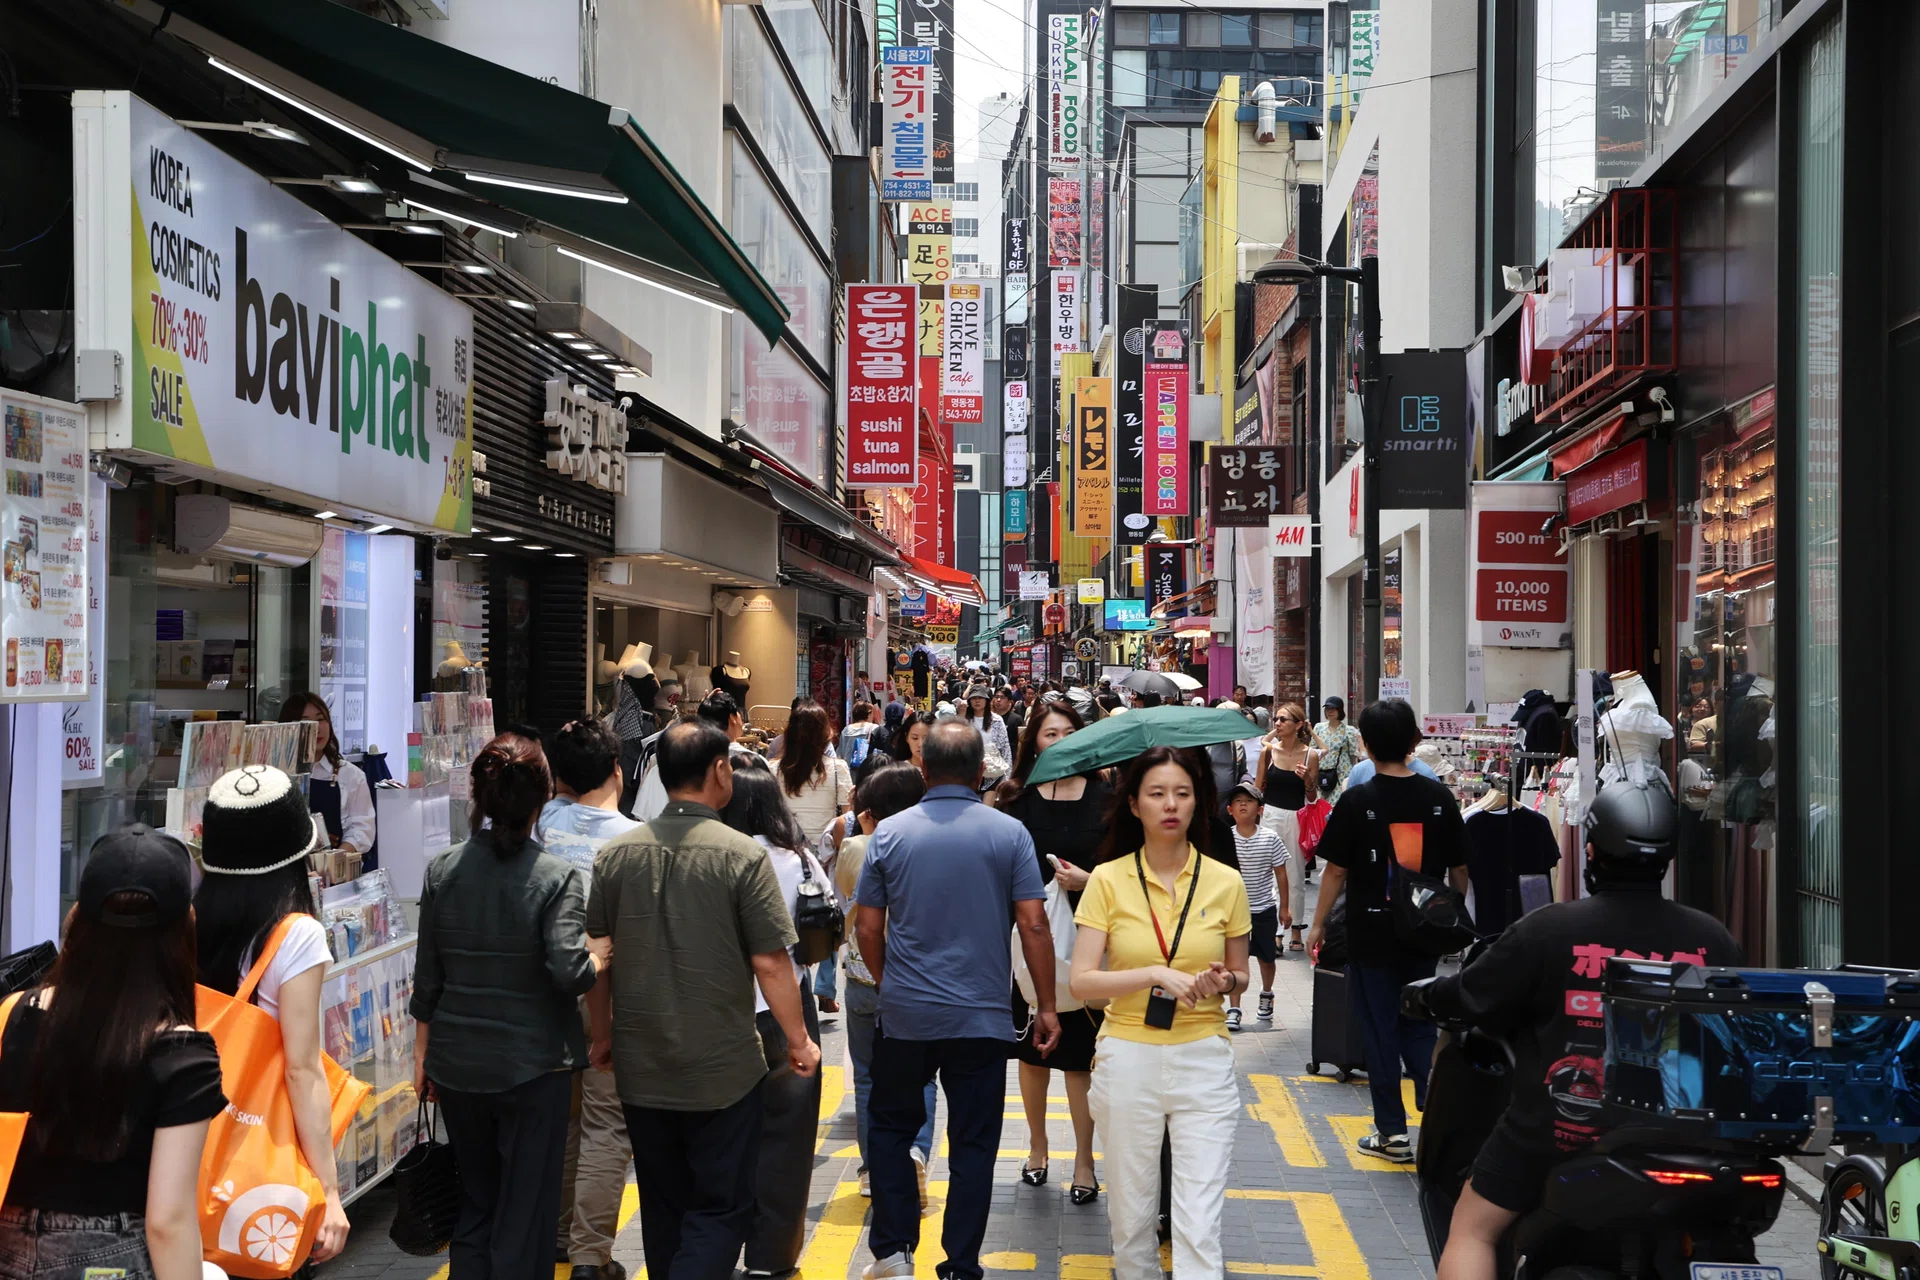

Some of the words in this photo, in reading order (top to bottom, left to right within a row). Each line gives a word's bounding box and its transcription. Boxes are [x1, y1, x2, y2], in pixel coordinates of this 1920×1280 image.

[886, 49, 930, 63] 서울전기
[1051, 17, 1062, 92] GURKHA
[1064, 18, 1078, 84] HALAL
[1064, 96, 1078, 154] FOOD
[150, 145, 194, 218] KOREA
[1050, 181, 1080, 190] BUFFET
[884, 190, 931, 198] 011-822-1108
[910, 208, 951, 222] ACE
[917, 223, 945, 234] 에이스
[150, 221, 221, 302] COSMETICS
[935, 246, 949, 286] FOO
[1008, 260, 1024, 269] 6F
[965, 301, 979, 350] OLIVE
[1058, 294, 1075, 340] 한우방
[856, 291, 908, 379] 은행골
[950, 301, 963, 372] CHICKEN
[235, 226, 431, 465] baviphat
[950, 371, 974, 387] cafe
[151, 364, 184, 427] SALE
[850, 386, 913, 403] 초밥&참치
[951, 398, 976, 408] 명동점
[945, 409, 981, 419] 543-7677
[1157, 377, 1177, 449] WAPPEN
[860, 417, 903, 432] sushi
[863, 438, 900, 453] tuna
[1084, 409, 1105, 470] レモン
[1383, 437, 1458, 451] smartti
[853, 459, 910, 475] salmon
[1220, 450, 1281, 480] 명동
[1157, 453, 1177, 510] HOUSE
[1220, 485, 1281, 513] 교자
[1010, 498, 1021, 527] 하모니
[1276, 526, 1305, 546] H&M
[1495, 532, 1525, 545] 500
[1159, 552, 1174, 565] K
[1495, 581, 1550, 596] 10,000
[1497, 599, 1548, 612] ITEMS
[65, 737, 92, 759] 60%
[78, 758, 96, 771] SALE
[236, 1110, 265, 1126] SKIN
[366, 1162, 377, 1179] SALE
